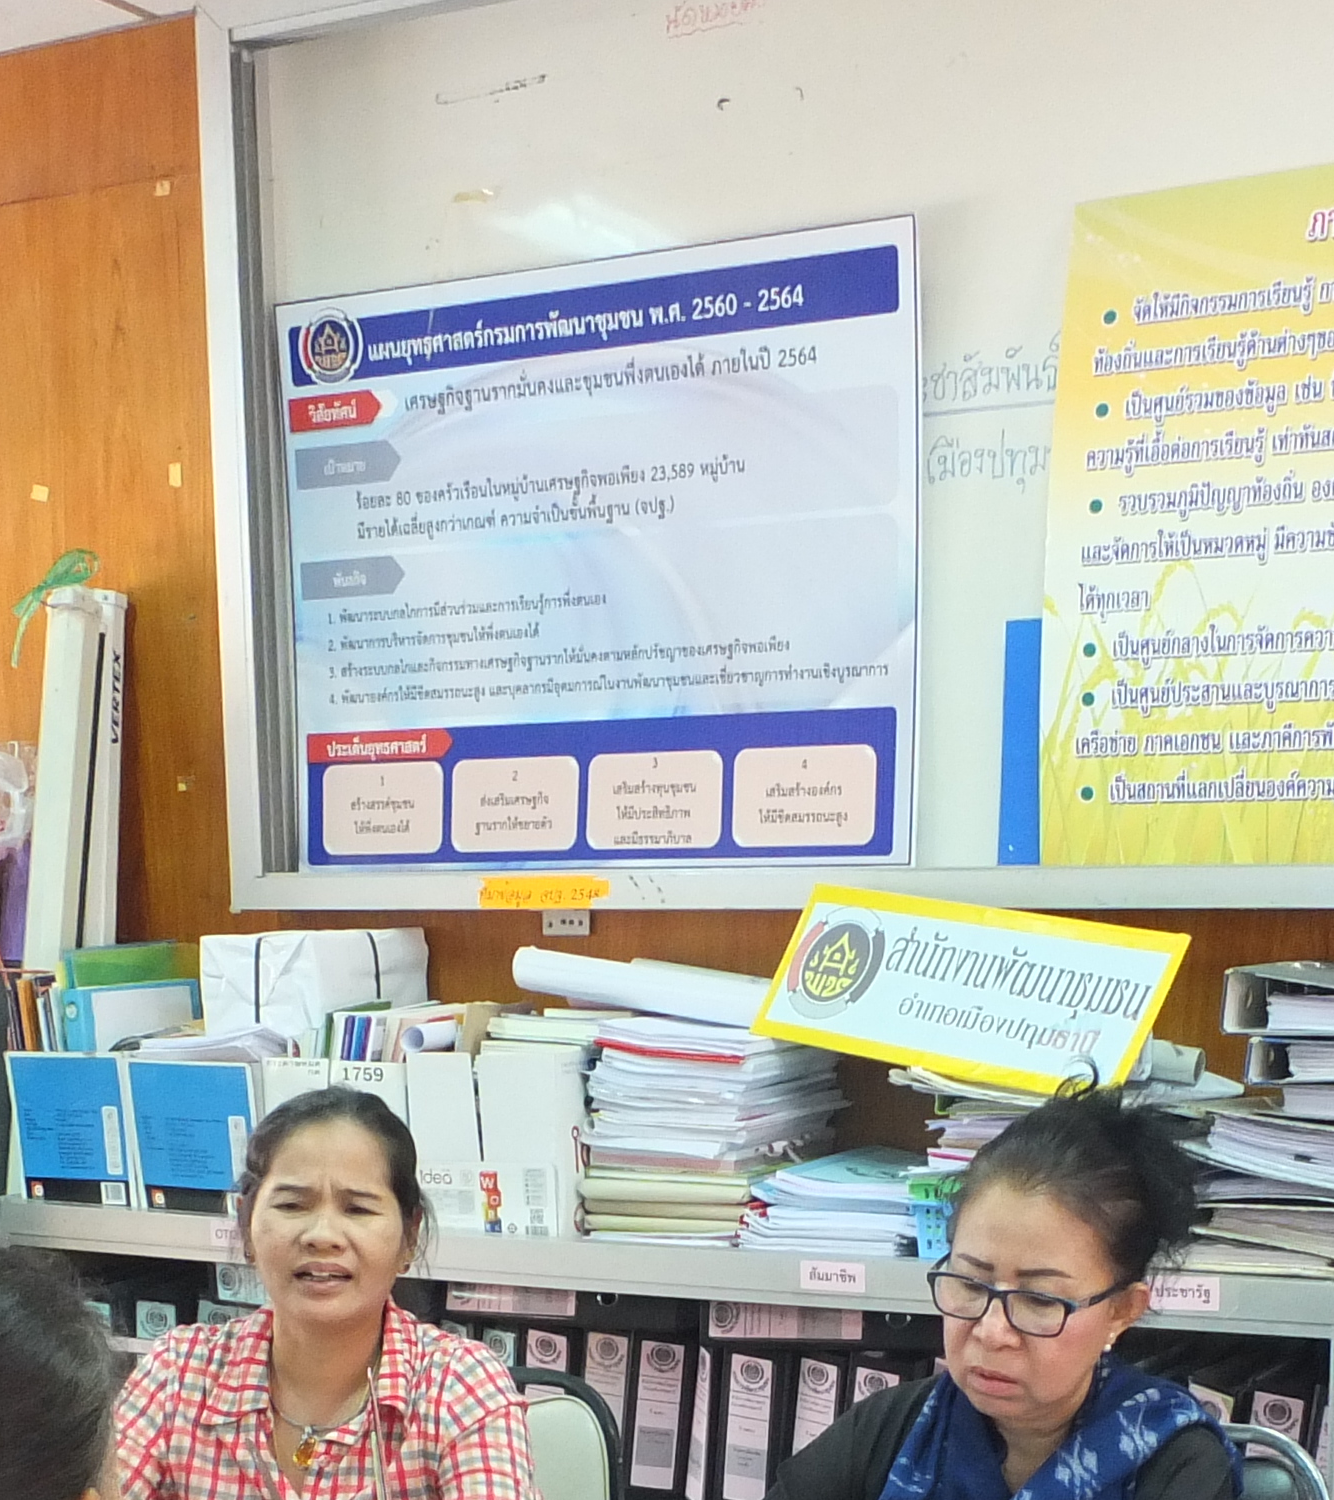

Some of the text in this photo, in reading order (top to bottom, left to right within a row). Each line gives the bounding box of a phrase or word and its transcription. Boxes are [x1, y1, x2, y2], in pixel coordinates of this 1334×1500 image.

[367, 307, 643, 364] แผนยุทธศาสตร์กรมการพัฒนาชุมชน
[649, 301, 686, 324] พ.ศ.
[692, 292, 737, 321] 2560
[758, 284, 804, 315] 2564
[711, 345, 771, 378] ภายในปี
[778, 345, 817, 370] 2564
[1124, 378, 1287, 423] เป็นศูนย์รวมของข้อมูล
[1294, 377, 1324, 404] เช่น
[356, 488, 391, 511] ร้อยละ
[396, 490, 410, 506] 80
[650, 462, 695, 484] 23,589
[700, 455, 746, 480] หมู่บ้าน
[1078, 583, 1150, 622] ได้ทุกเวลา
[328, 639, 336, 651] 2.
[1075, 732, 1138, 757] เครือข่าย
[1143, 730, 1222, 755] ภาคเอกชน
[884, 926, 1152, 1021] สำนักงานพัฒนาชุมชน
[343, 1067, 384, 1081] 1759
[809, 1265, 857, 1285] สัมมาชีพ
[1155, 1283, 1211, 1304] ประชารัฐ
